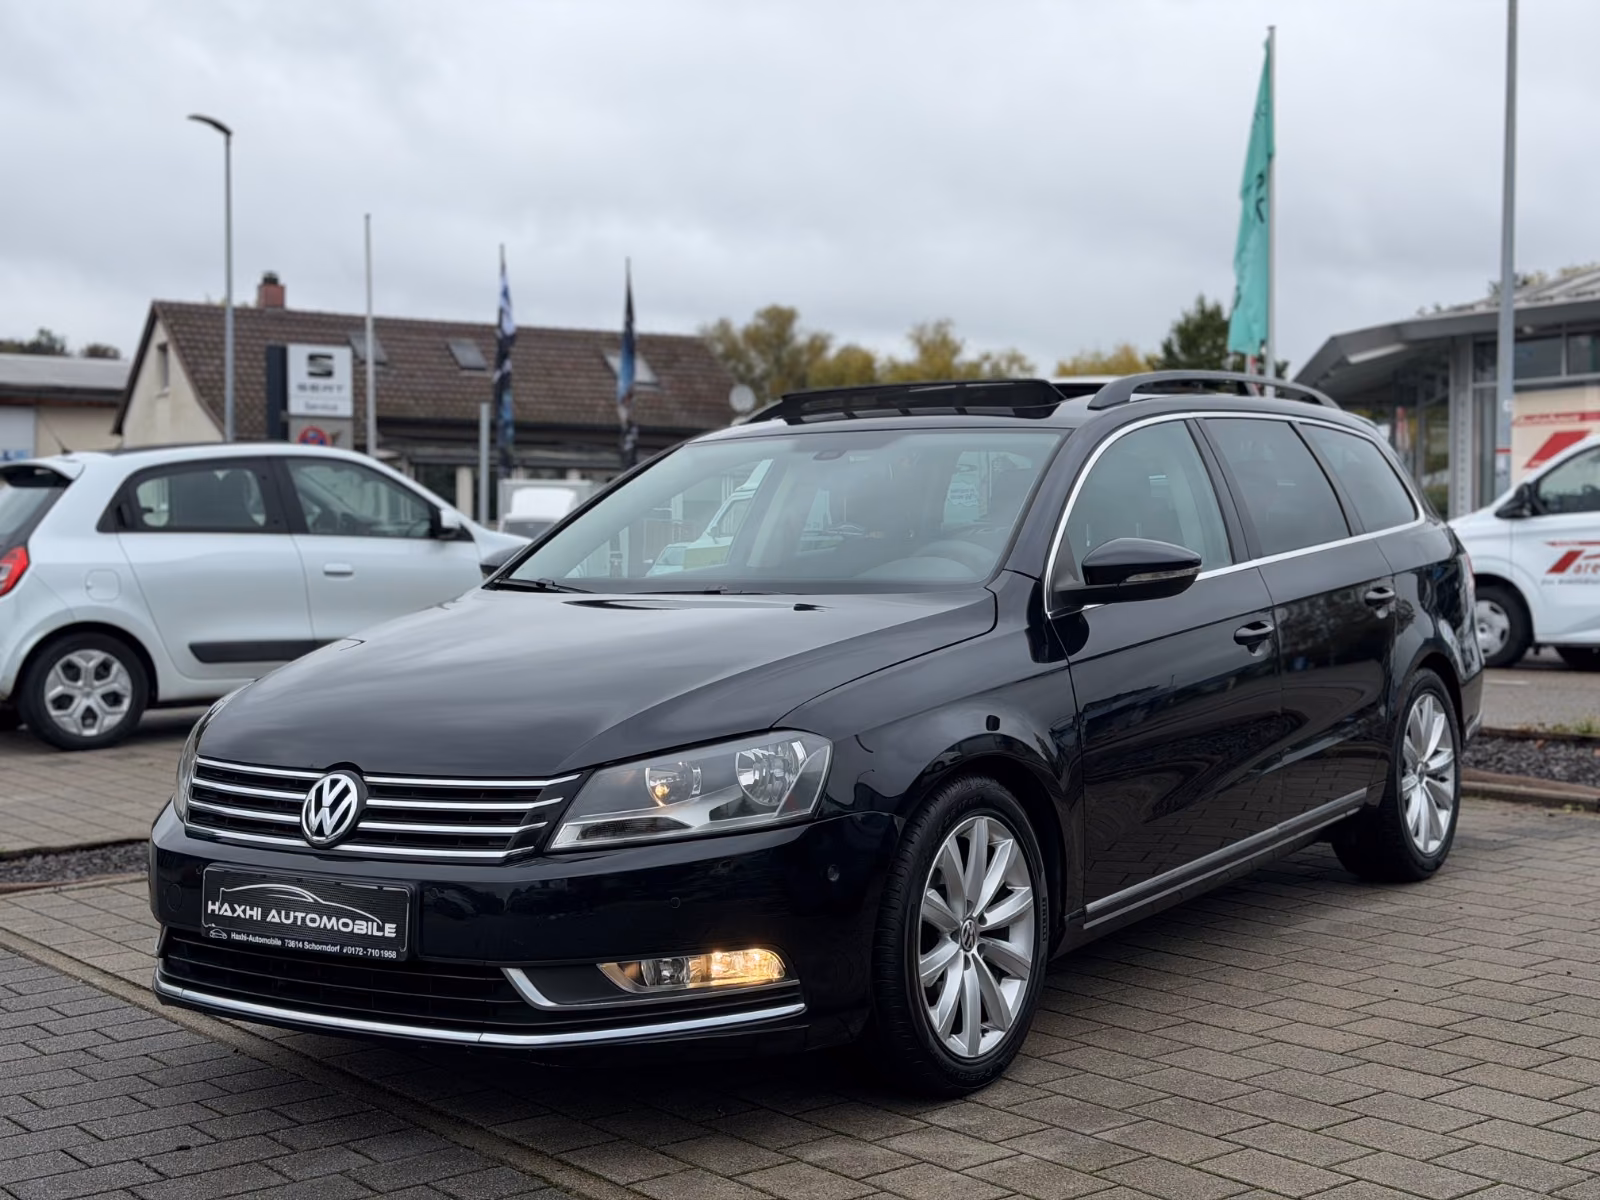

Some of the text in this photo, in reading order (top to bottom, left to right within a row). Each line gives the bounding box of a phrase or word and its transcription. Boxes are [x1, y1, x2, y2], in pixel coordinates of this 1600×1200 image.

[207, 900, 397, 938] HAXHI AUTOMOBILE
[303, 941, 340, 953] Schorndorf
